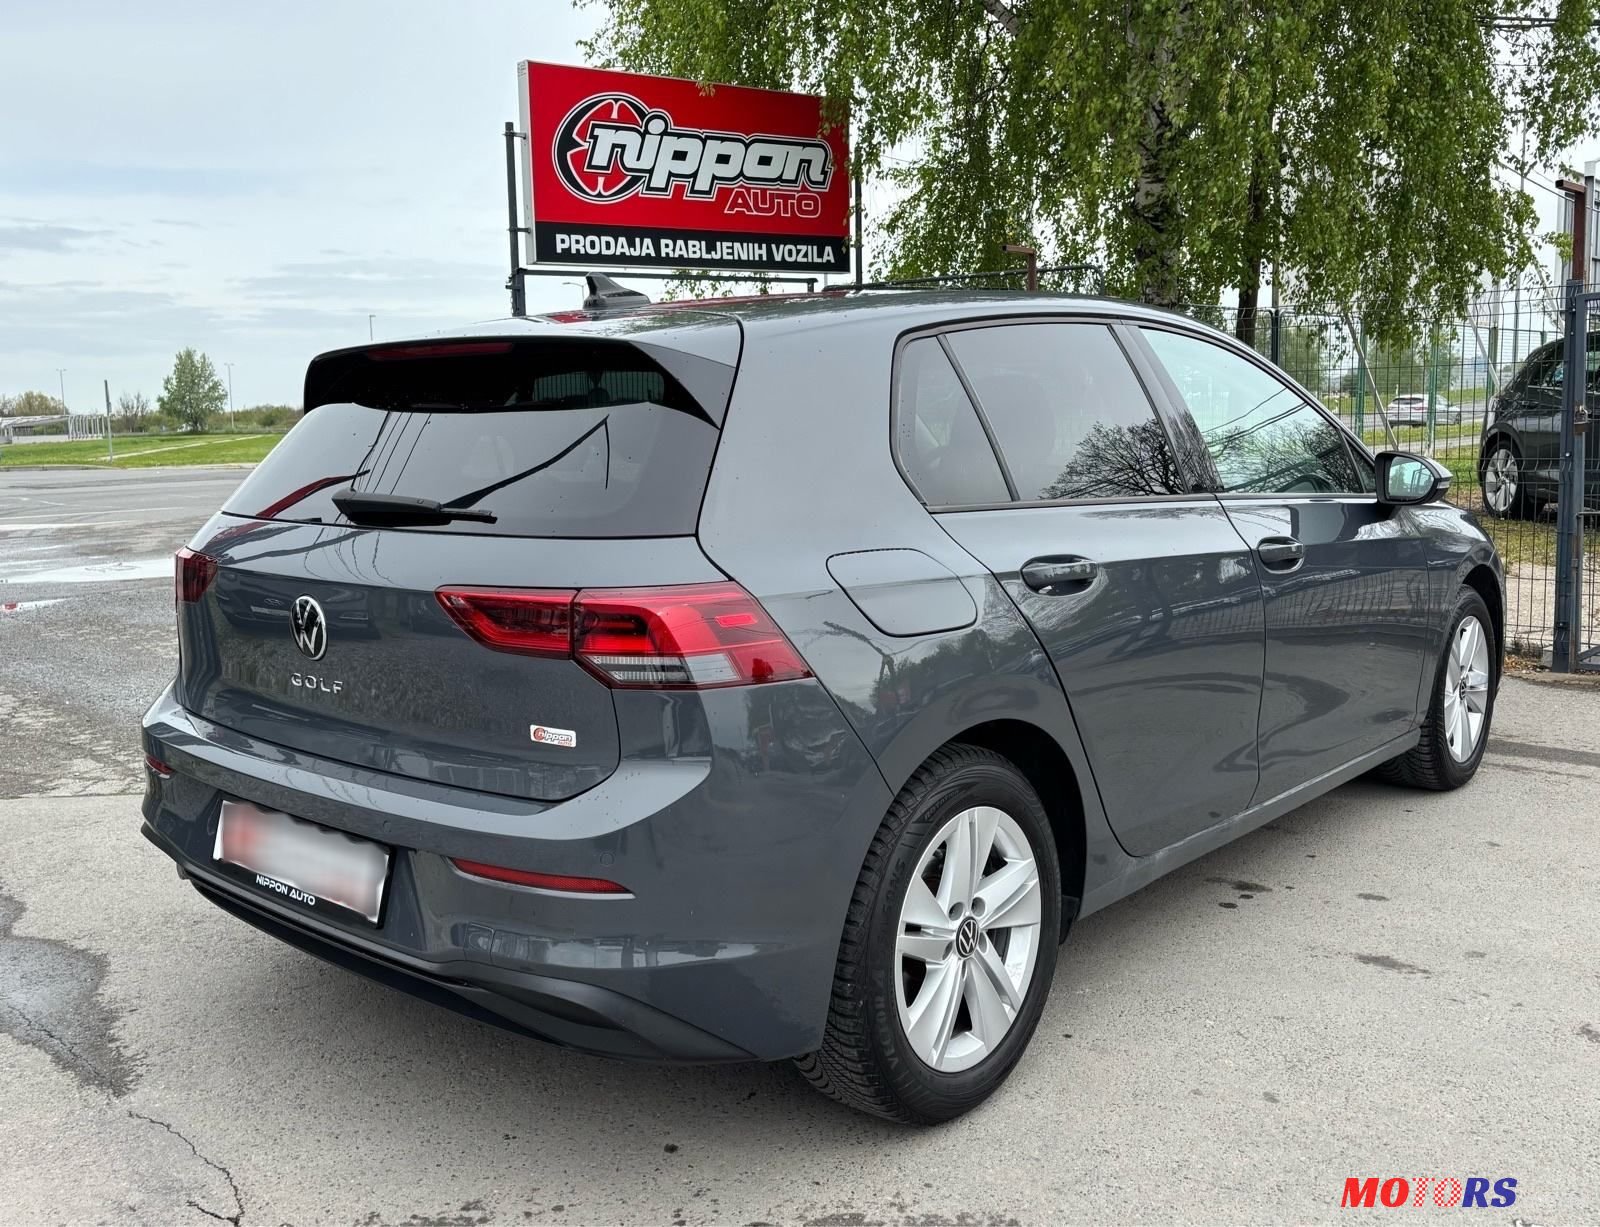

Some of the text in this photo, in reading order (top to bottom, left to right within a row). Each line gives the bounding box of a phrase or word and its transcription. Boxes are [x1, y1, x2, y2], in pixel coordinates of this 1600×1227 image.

[586, 112, 829, 196] nippon
[724, 188, 821, 218] AUTO
[555, 233, 836, 264] PRODAJA RABLJENIH VOZILA
[291, 672, 343, 694] GOLF
[256, 873, 316, 906] NIPPON AUTO
